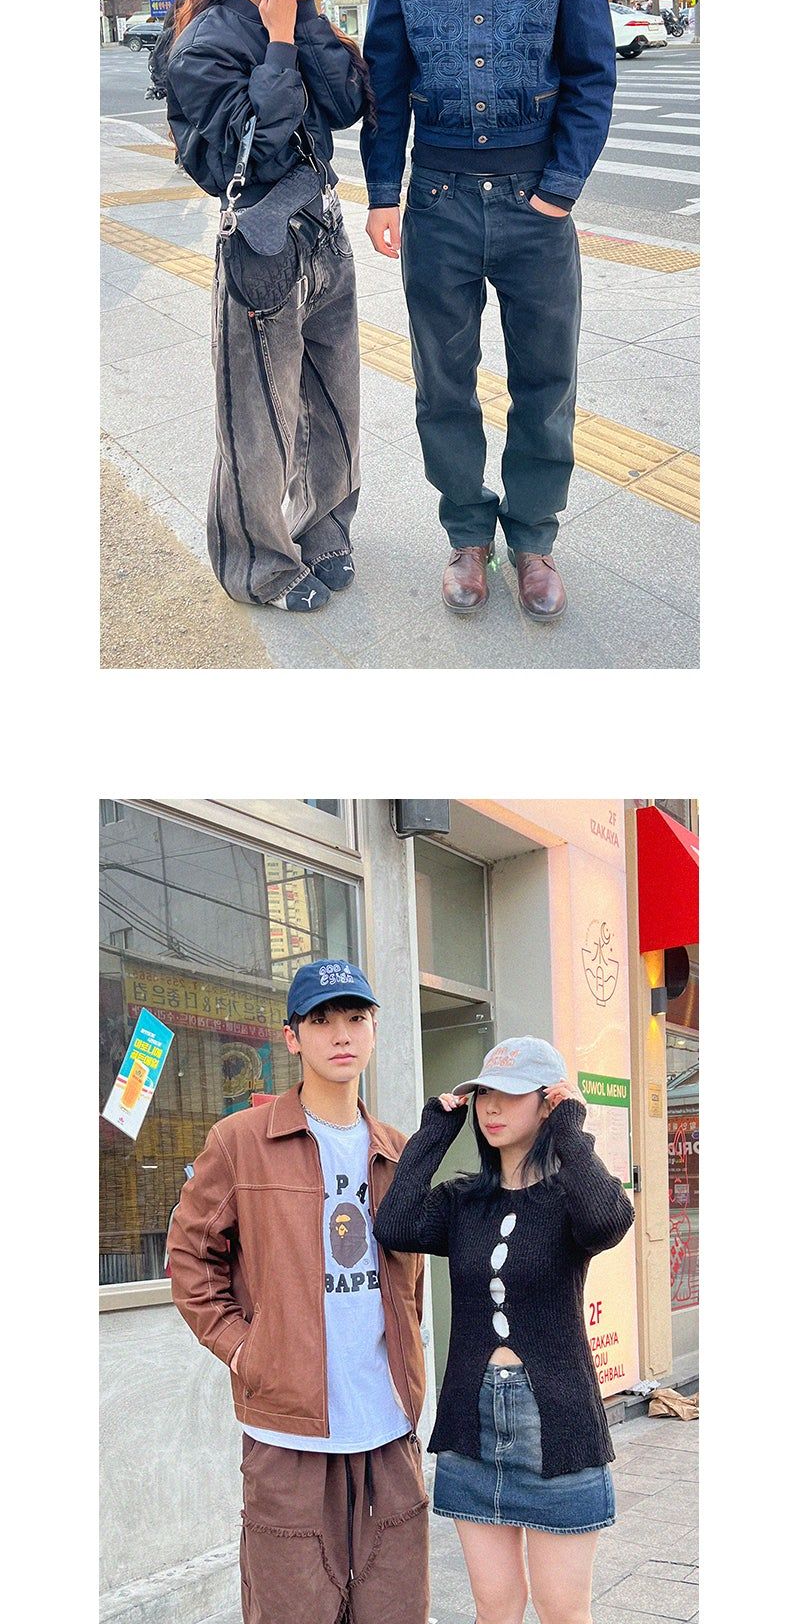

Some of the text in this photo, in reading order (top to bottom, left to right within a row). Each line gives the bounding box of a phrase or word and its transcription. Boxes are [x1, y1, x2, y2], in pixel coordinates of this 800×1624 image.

[608, 810, 617, 827] 2F
[590, 818, 620, 848] IZAKAYA
[582, 1079, 627, 1098] SUWOL MENU
[325, 1270, 379, 1293] BAPE
[589, 1301, 603, 1327] 2F
[593, 1352, 608, 1368] OJU
[597, 1364, 625, 1384] GHBALL
